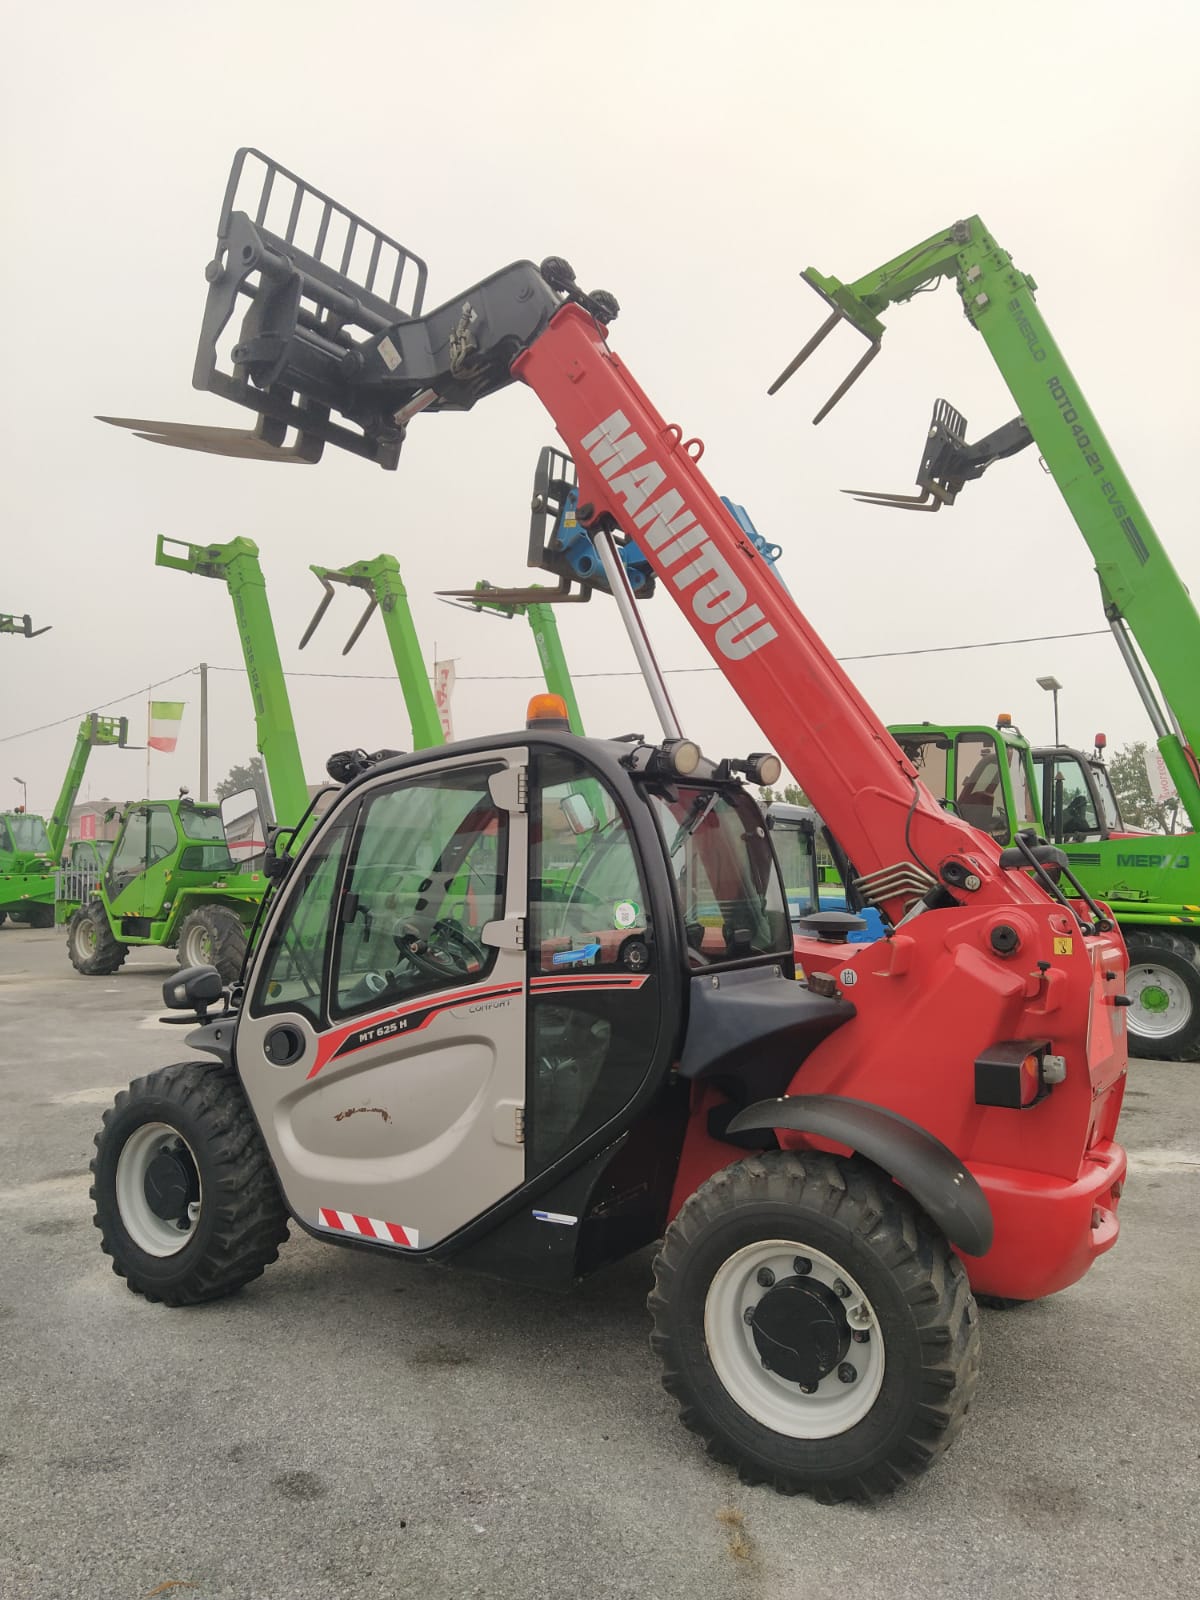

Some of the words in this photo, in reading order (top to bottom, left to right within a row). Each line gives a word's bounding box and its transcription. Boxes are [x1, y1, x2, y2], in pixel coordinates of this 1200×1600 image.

[1011, 308, 1048, 363] MERLO
[580, 409, 779, 660] MANITOU
[359, 1030, 375, 1042] MT
[376, 1024, 398, 1037] 625
[399, 1019, 408, 1029] H
